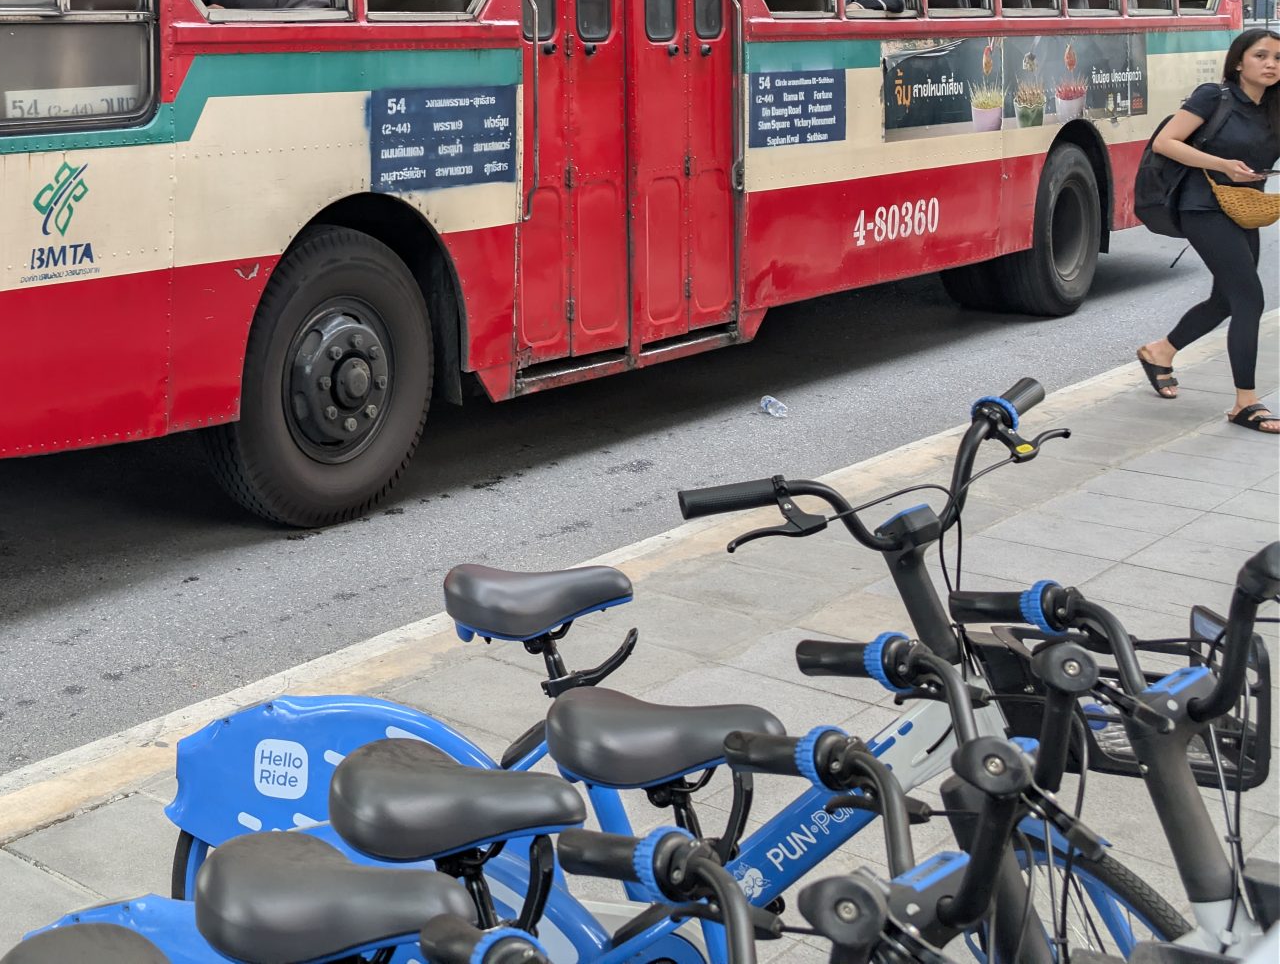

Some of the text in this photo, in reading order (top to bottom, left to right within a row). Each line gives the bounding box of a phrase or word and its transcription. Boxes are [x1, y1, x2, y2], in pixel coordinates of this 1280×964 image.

[759, 76, 771, 89] 54
[756, 94, 774, 104] (2-44)
[783, 92, 798, 101] Rama
[813, 91, 832, 100] Fortune
[11, 99, 40, 118] 54
[48, 103, 94, 117] (2-44)
[387, 98, 407, 115] 54
[787, 104, 801, 115] Road
[382, 123, 411, 135] (2-44)
[771, 119, 790, 131] Square
[793, 117, 812, 128] Victory
[807, 132, 828, 142] Suthisan
[853, 197, 940, 246] 4-80360
[30, 243, 94, 270] BMTA
[260, 749, 303, 769] Hello
[260, 769, 298, 787] Ride
[766, 824, 817, 872] PUN
